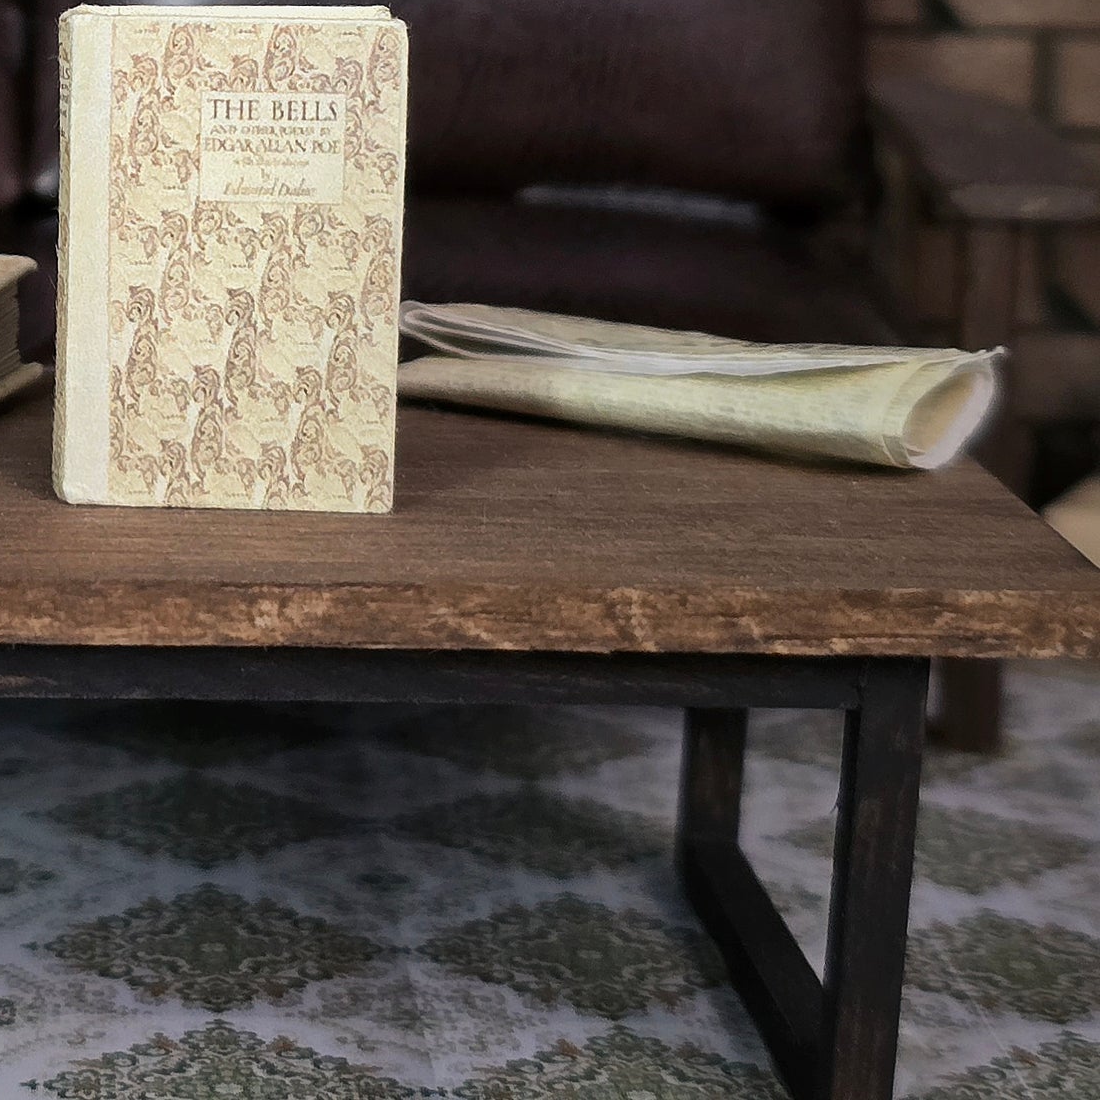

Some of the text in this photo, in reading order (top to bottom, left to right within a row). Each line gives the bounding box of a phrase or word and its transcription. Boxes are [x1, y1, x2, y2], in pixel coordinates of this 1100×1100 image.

[207, 99, 338, 122] THE BELLS
[210, 124, 238, 136] AND
[204, 137, 341, 155] EDGAR ALLAN POE
